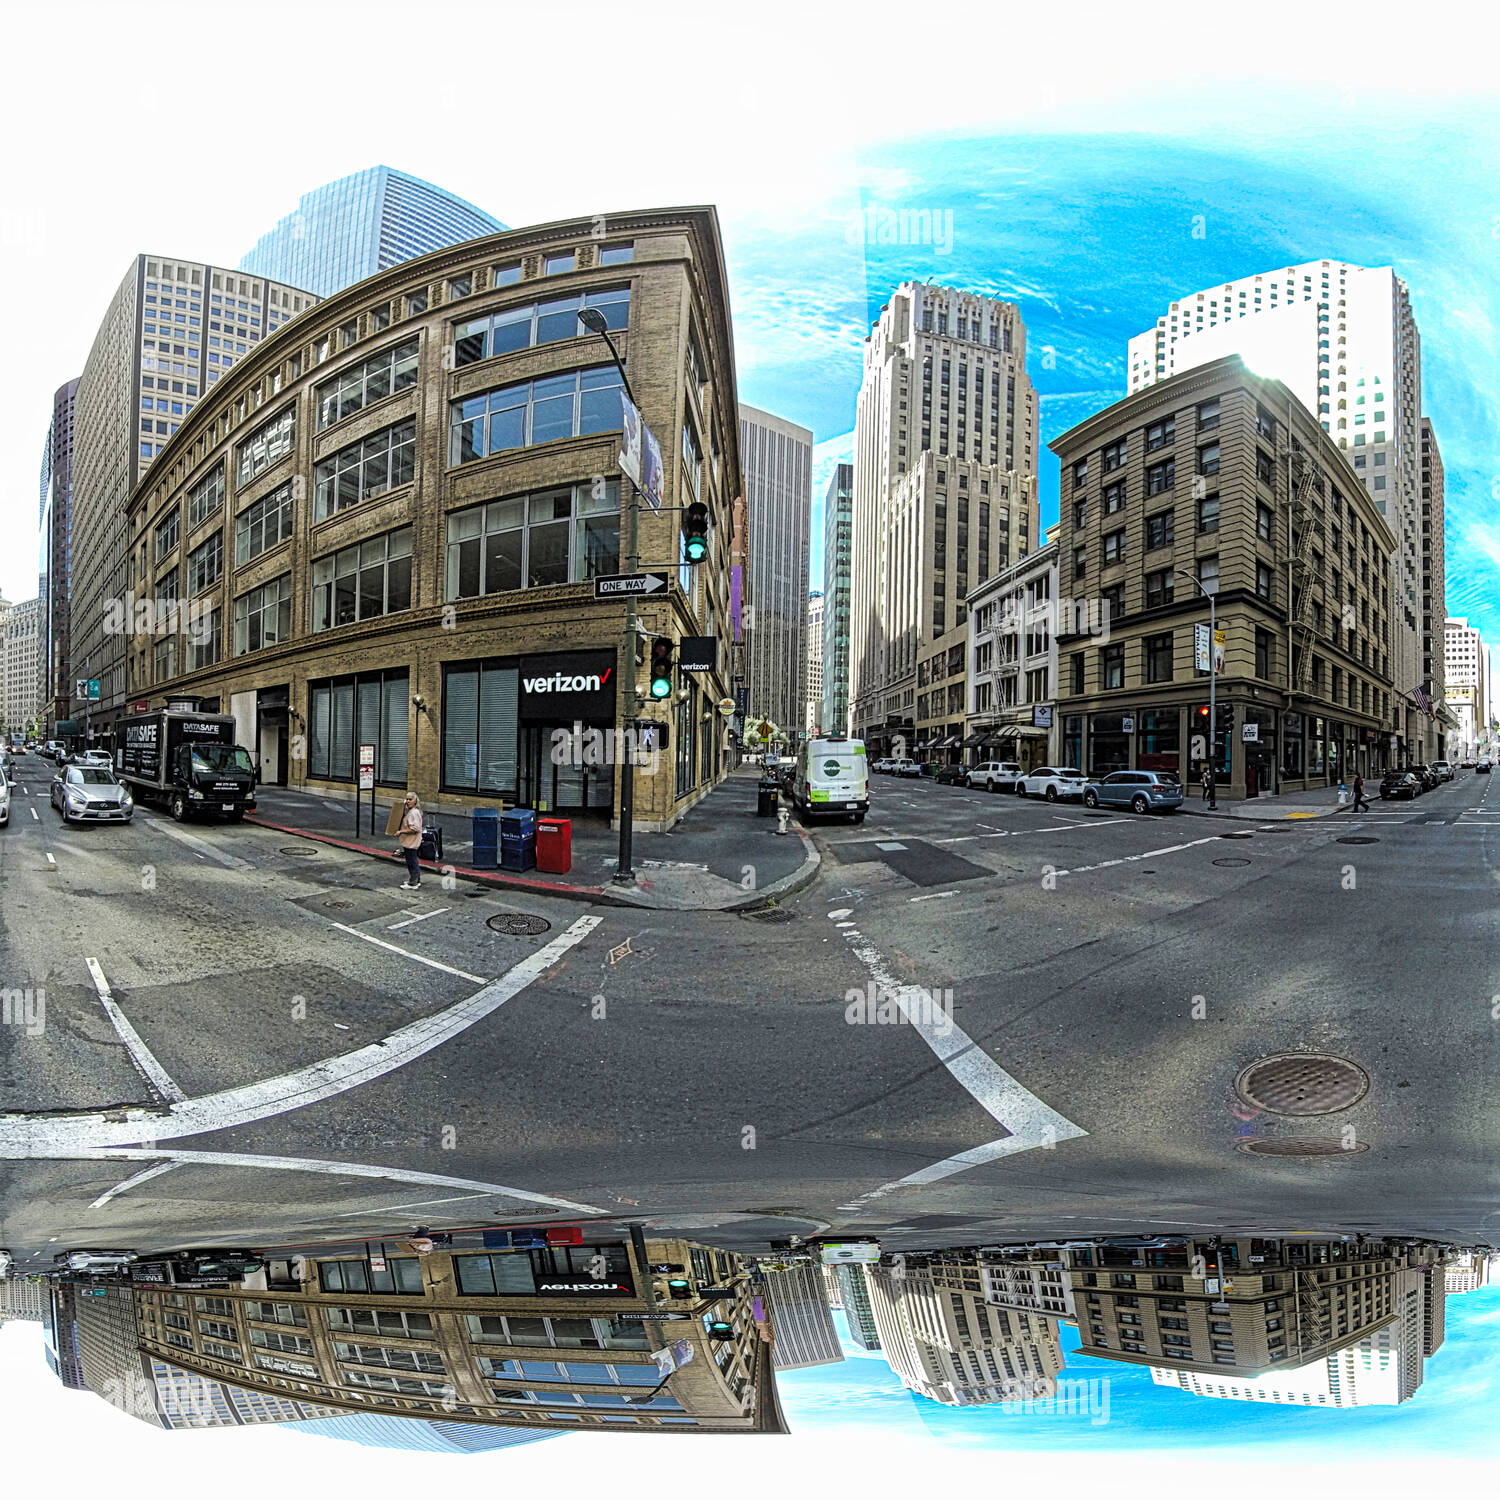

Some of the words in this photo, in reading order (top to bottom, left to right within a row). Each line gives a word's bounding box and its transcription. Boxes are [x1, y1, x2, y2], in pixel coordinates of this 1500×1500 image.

[602, 581, 622, 591] ONE
[625, 579, 646, 589] WAY
[681, 663, 709, 671] verizon
[523, 672, 600, 693] verizon
[183, 722, 219, 731] DATASAFE
[127, 725, 157, 741] DATASAFE
